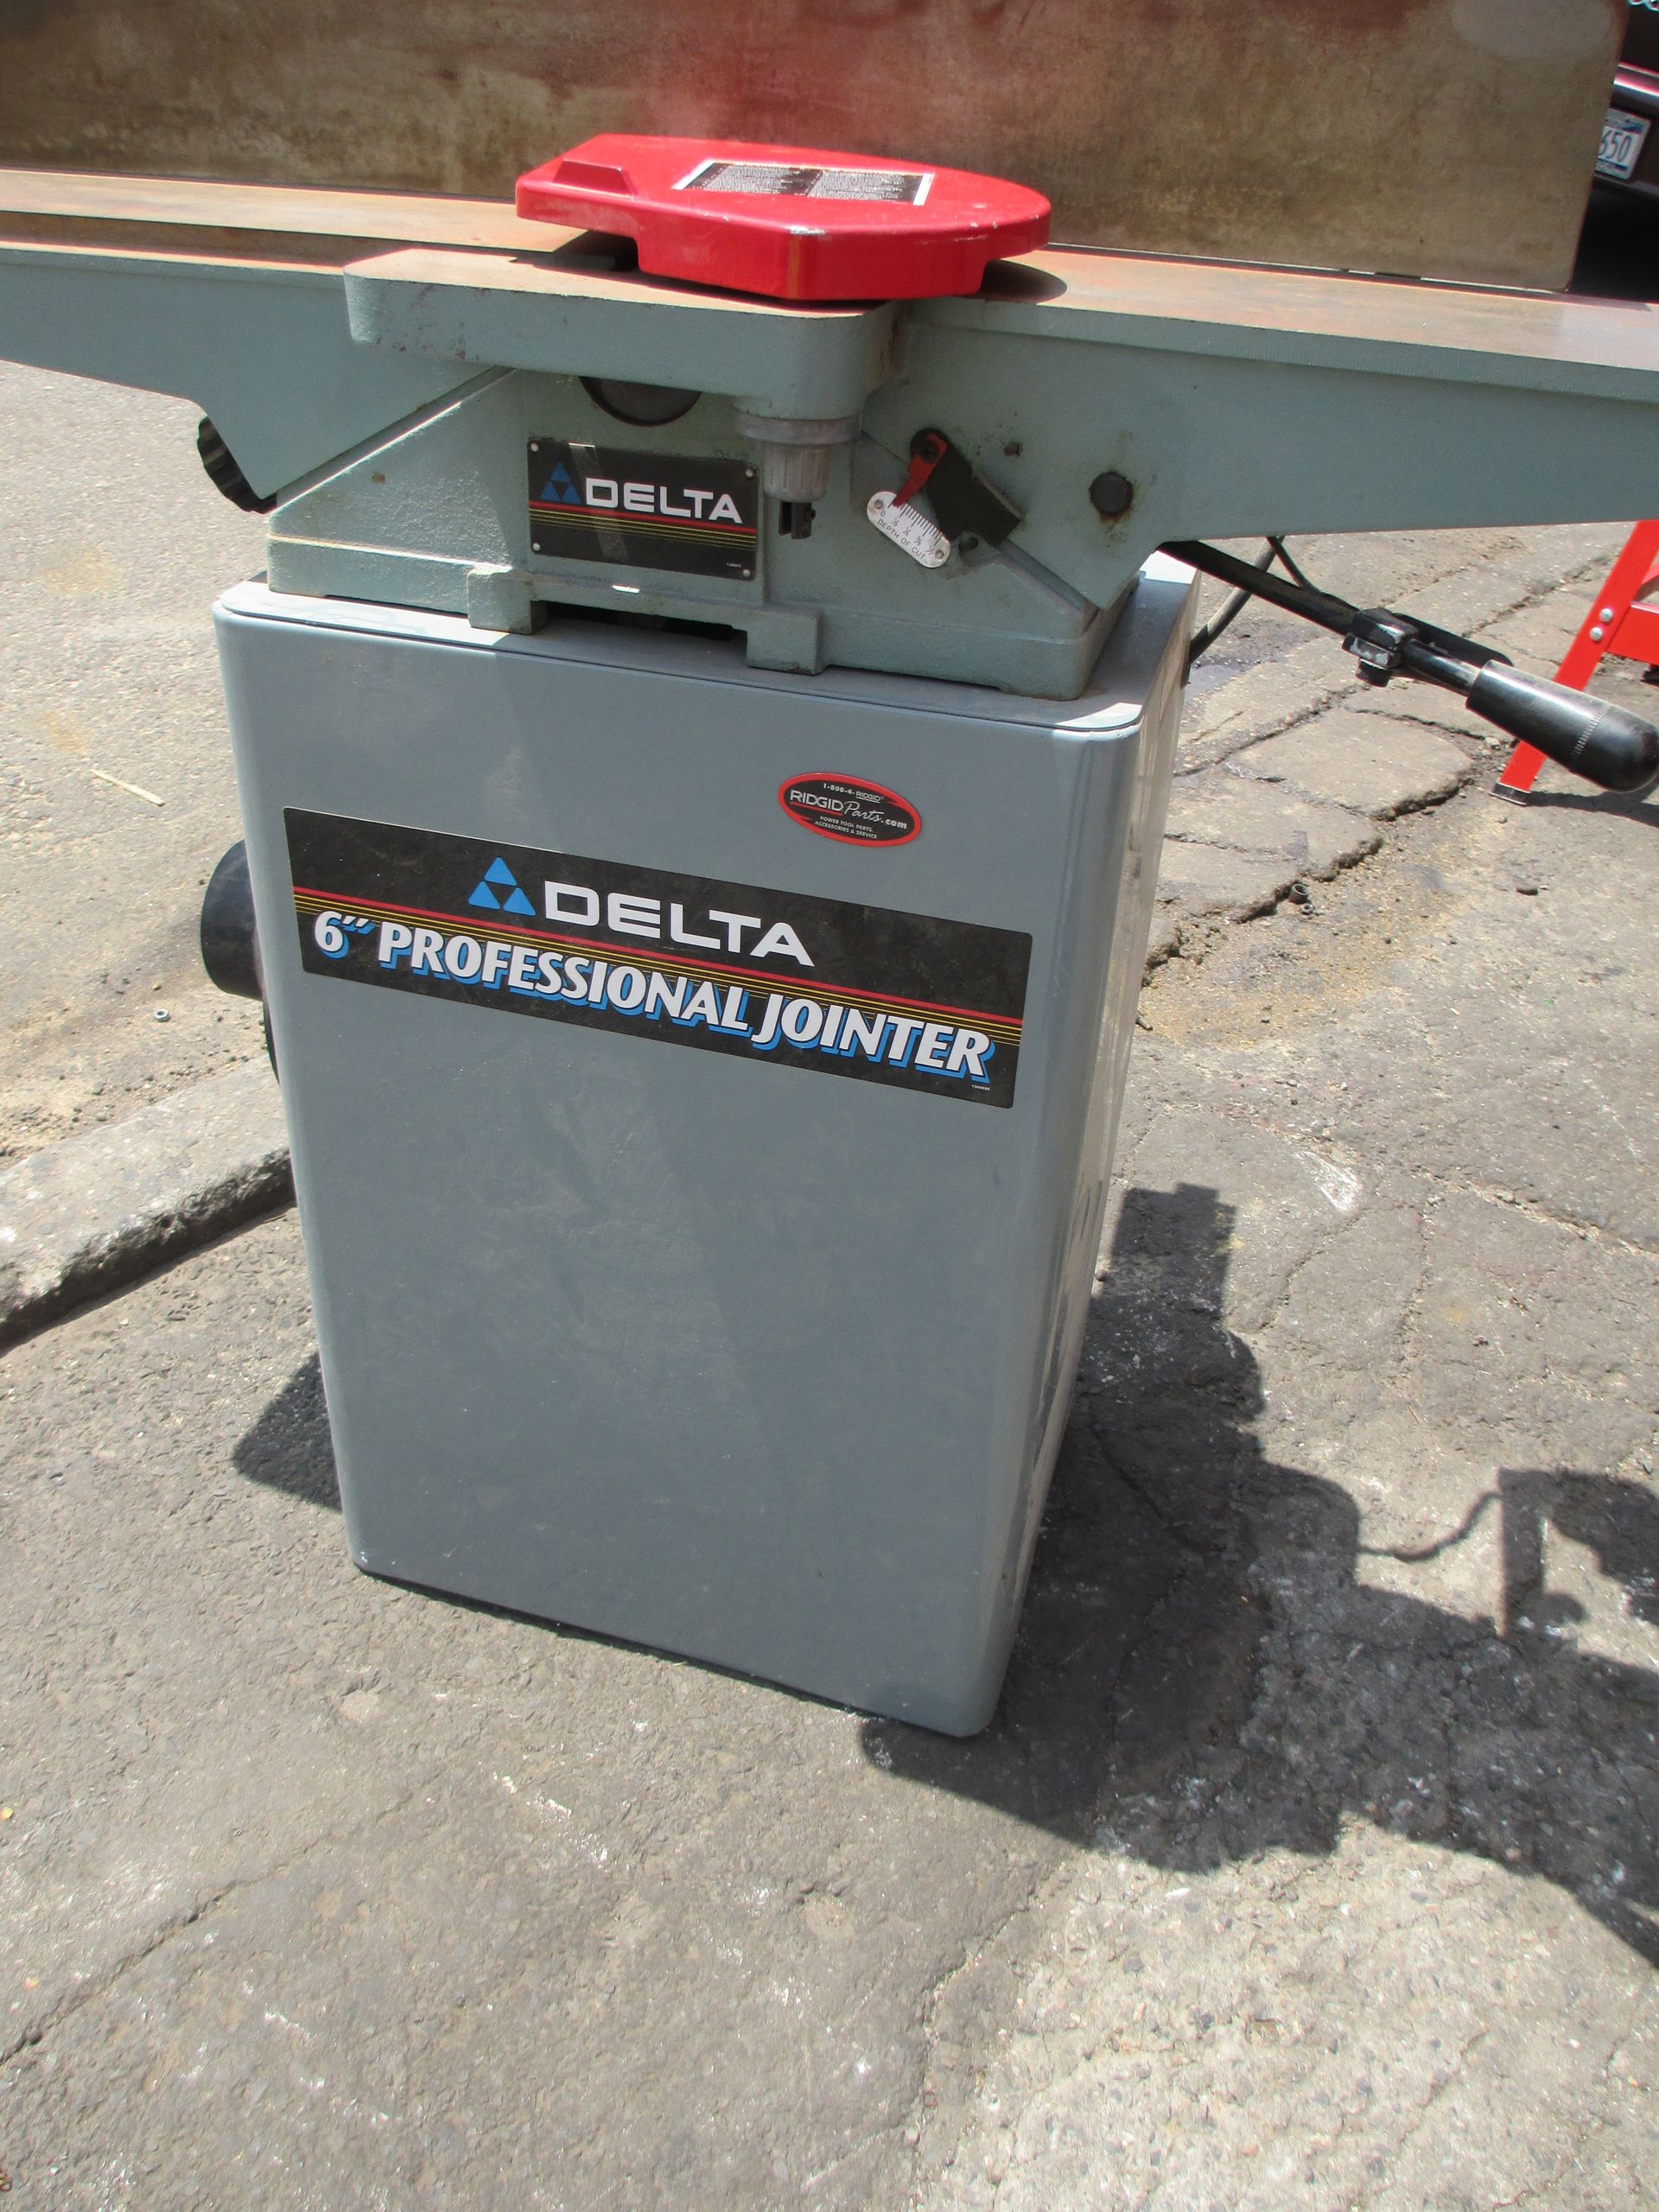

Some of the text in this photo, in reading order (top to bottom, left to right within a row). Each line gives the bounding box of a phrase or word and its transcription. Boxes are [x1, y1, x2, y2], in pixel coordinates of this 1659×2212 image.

[586, 477, 742, 524] DELTA
[877, 518, 926, 560] DEPTH OF CUT
[815, 820, 849, 833] ACCESSORIES
[855, 830, 878, 839] SERVICE
[820, 816, 840, 824] POWER
[544, 880, 815, 968] DELTA
[314, 910, 995, 1084] 6" PROFESSIONAL JOINTER
